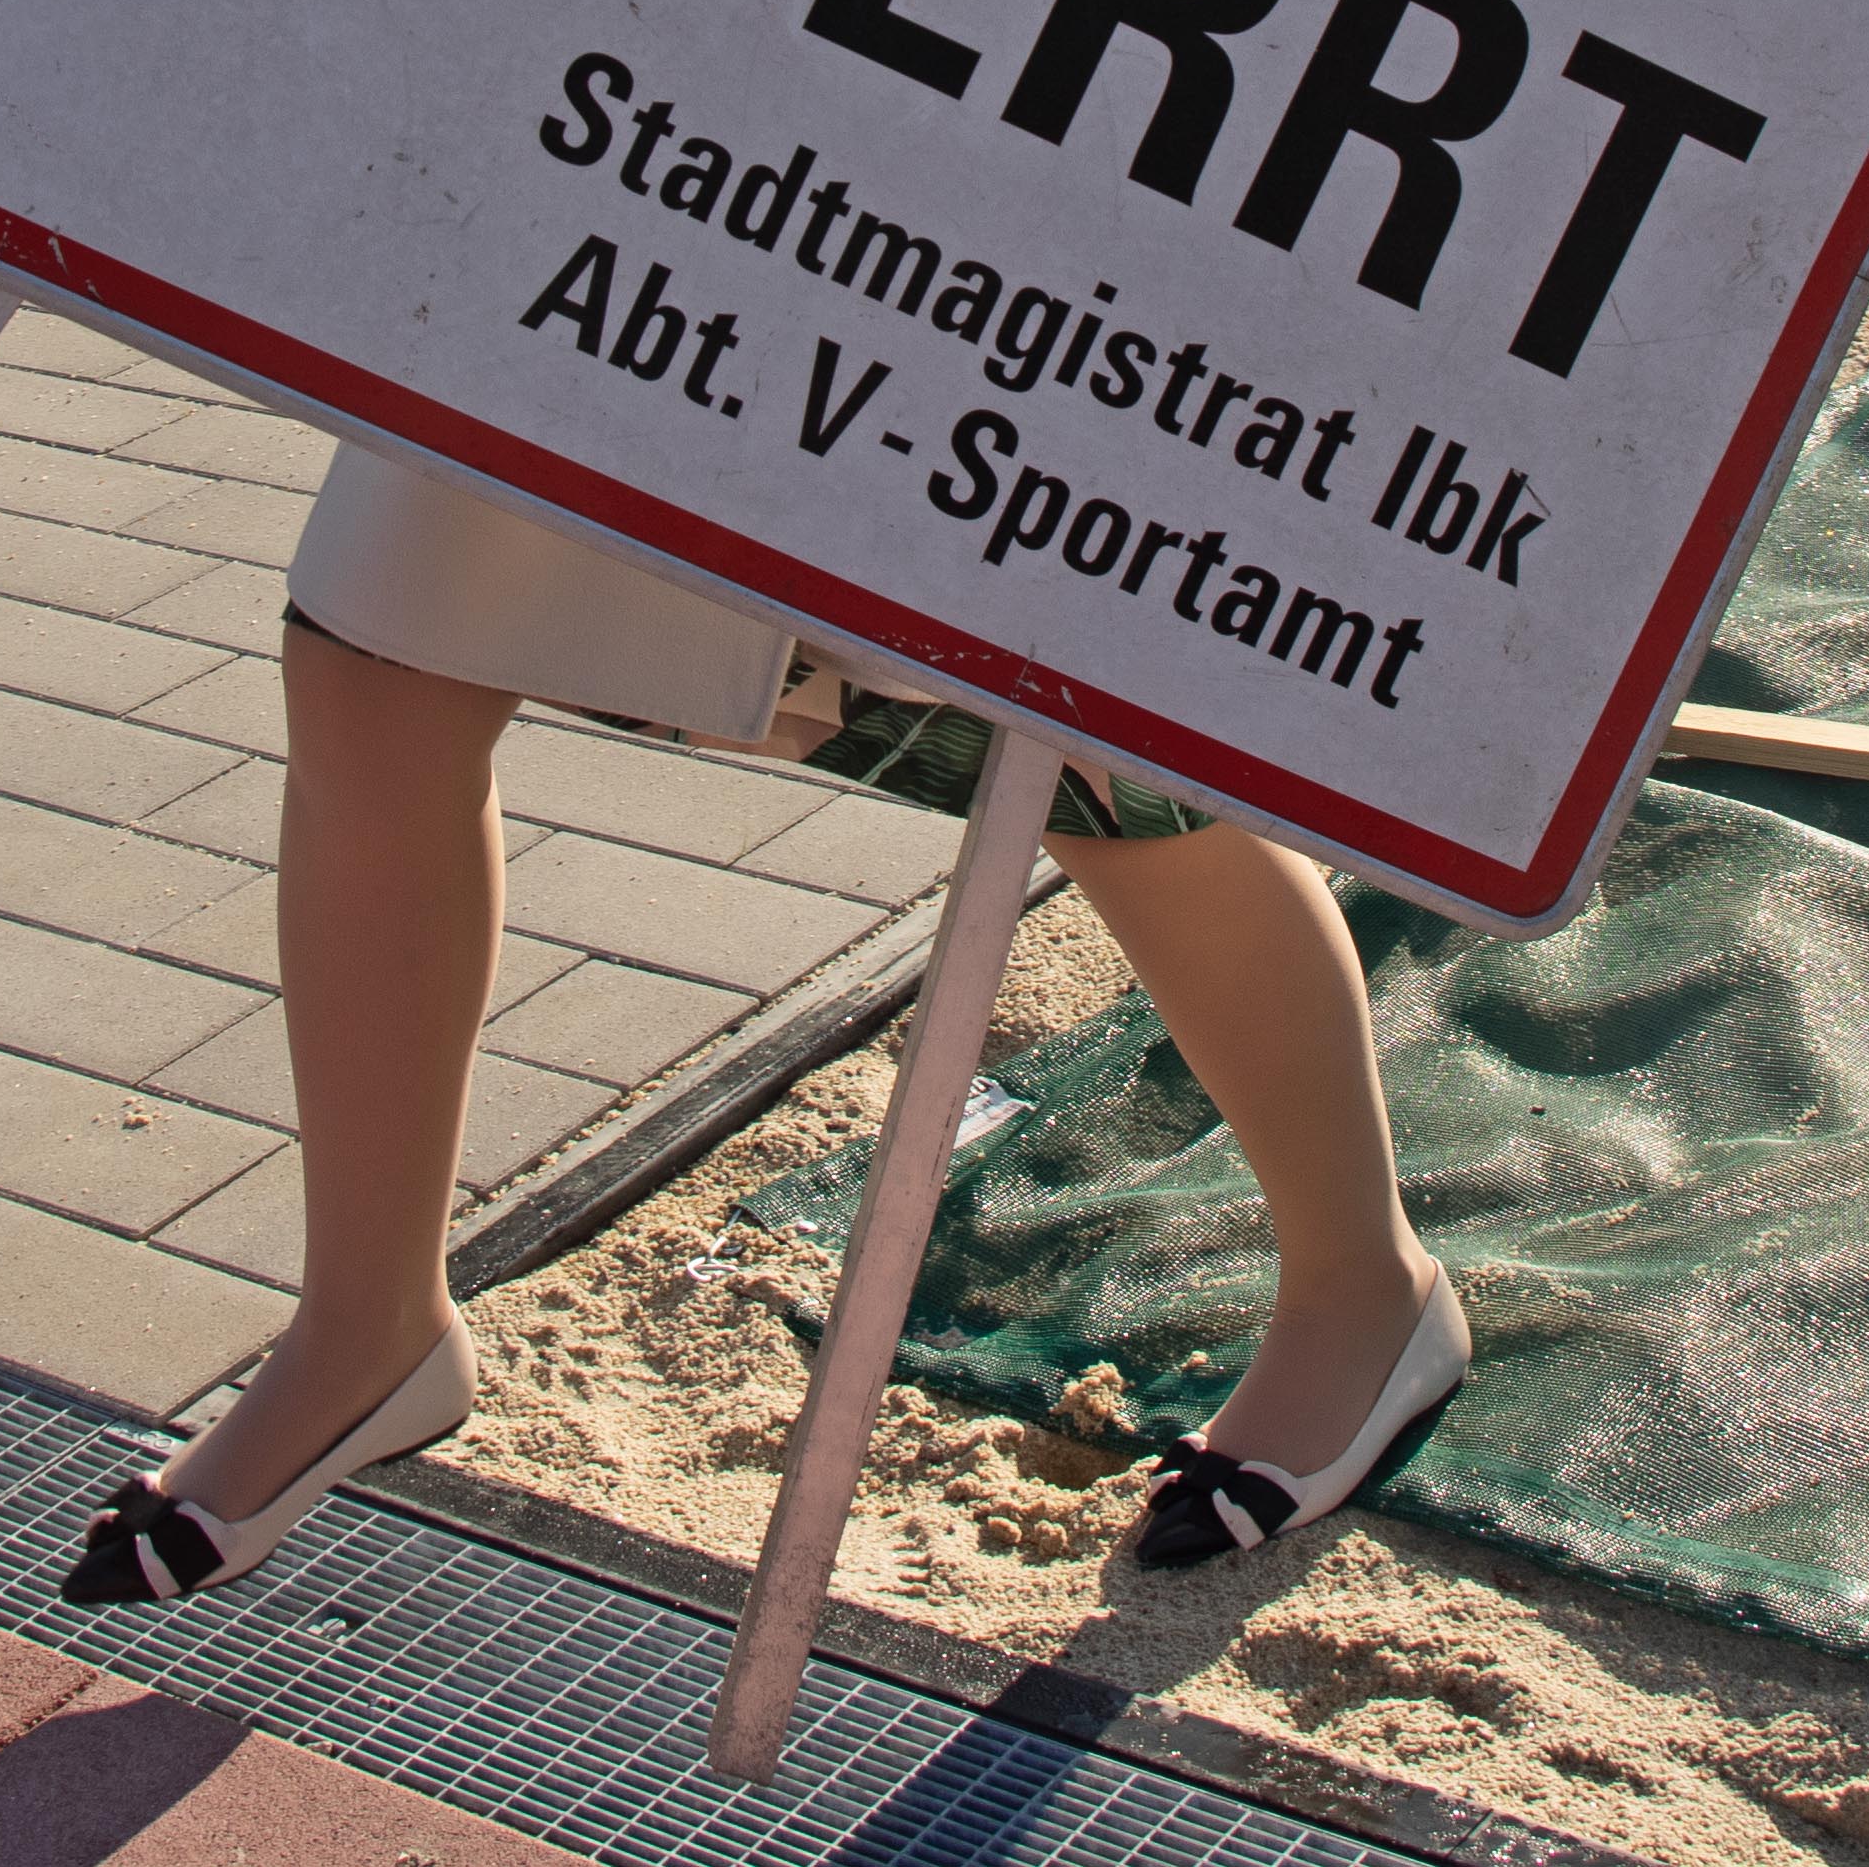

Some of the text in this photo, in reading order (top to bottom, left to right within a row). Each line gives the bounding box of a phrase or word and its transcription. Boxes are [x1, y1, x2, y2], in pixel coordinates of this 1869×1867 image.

[516, 232, 745, 421] Abt.
[537, 50, 1547, 590] Stadtmagistrat Ibk
